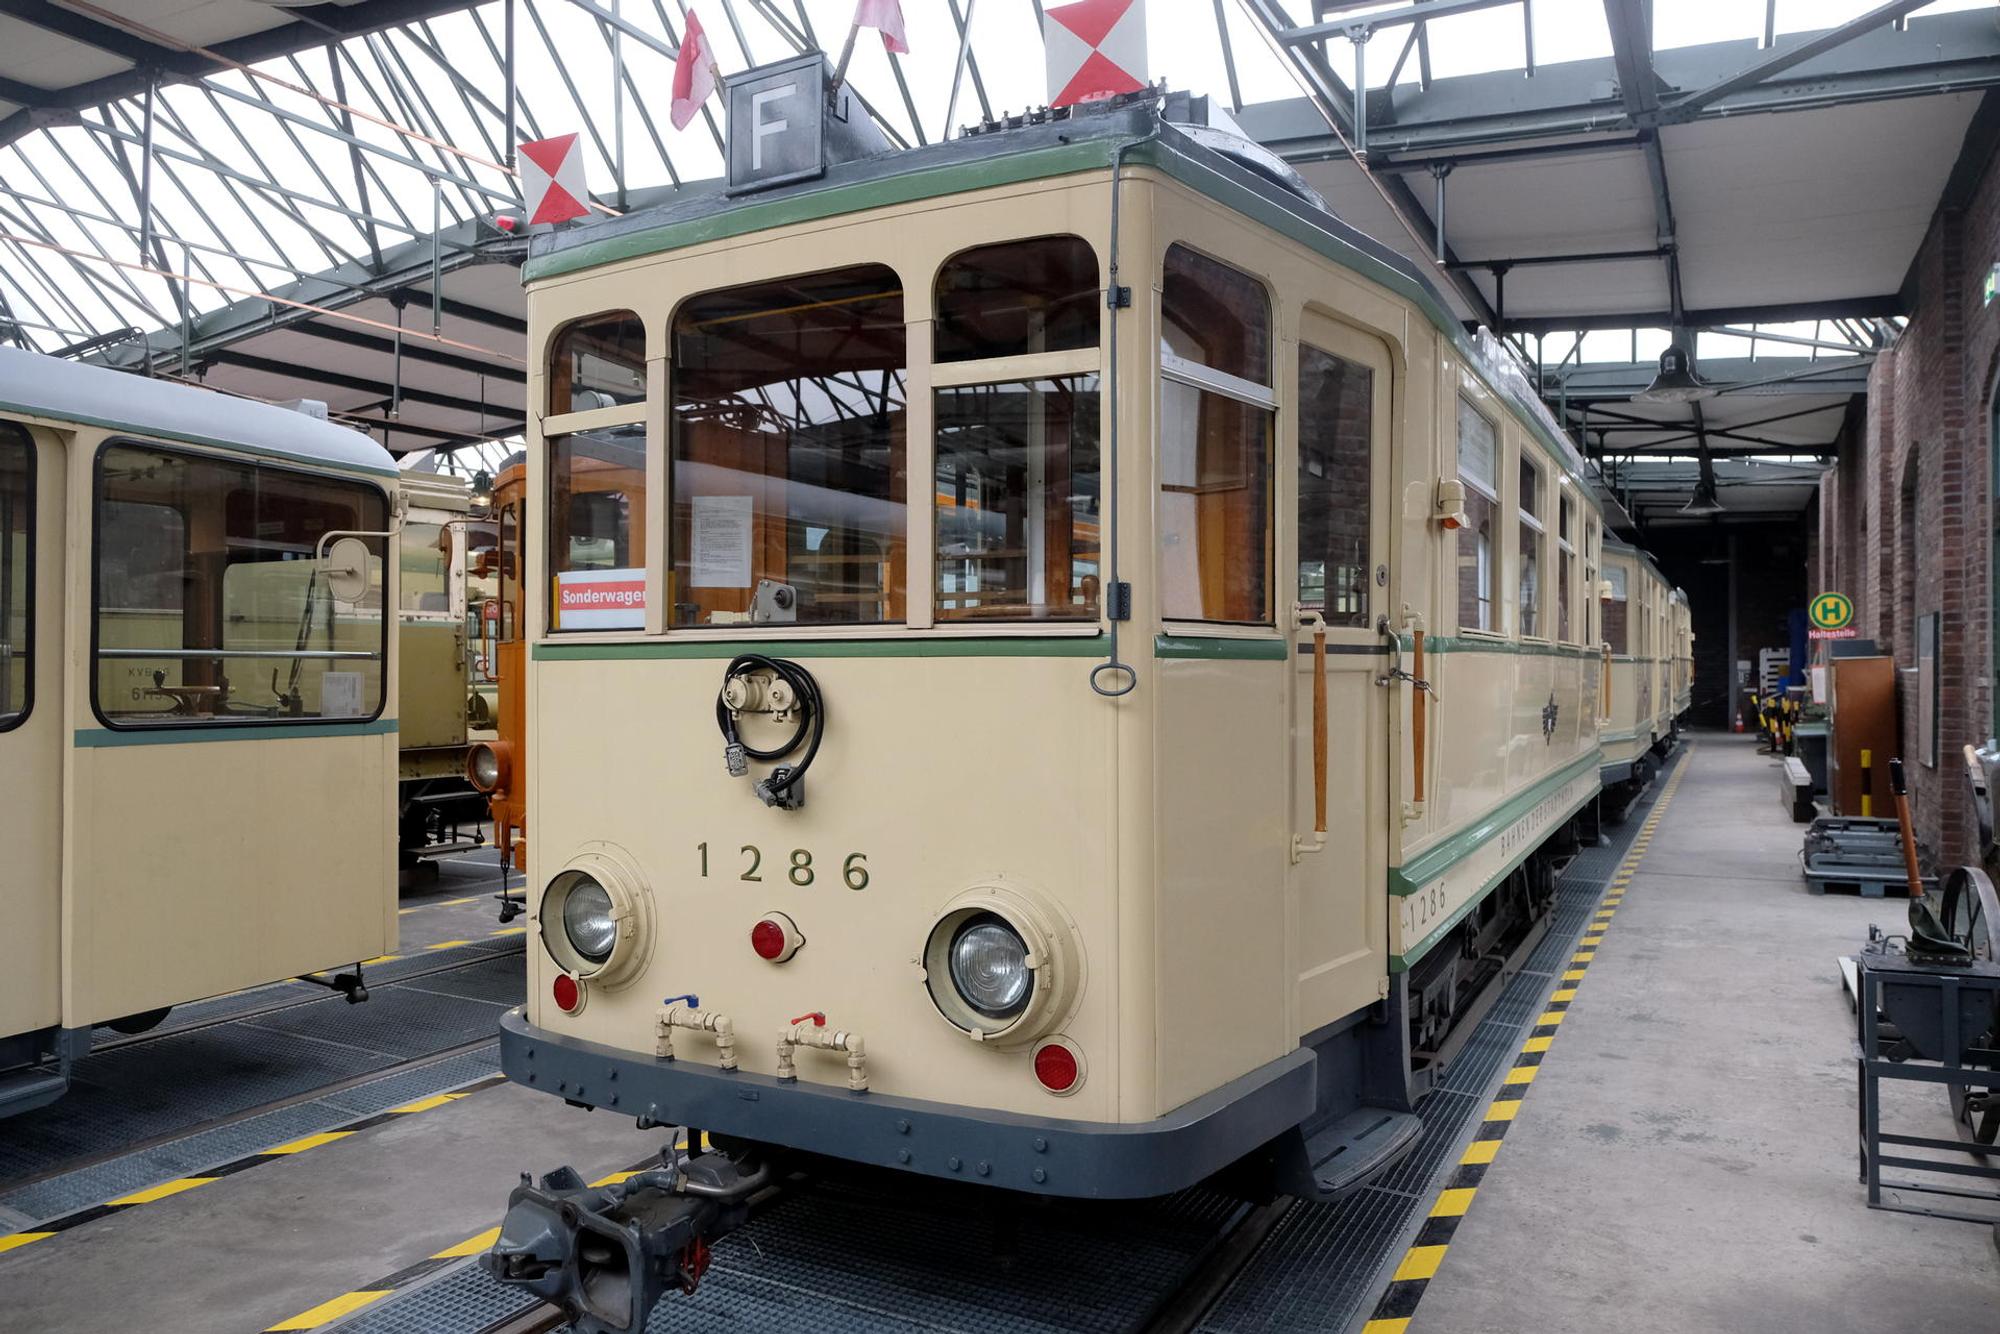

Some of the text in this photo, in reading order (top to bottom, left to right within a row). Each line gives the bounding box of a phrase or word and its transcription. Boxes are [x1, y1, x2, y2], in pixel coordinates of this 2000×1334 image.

[752, 83, 797, 171] F
[1808, 629, 1856, 639] Haltestelle
[1822, 601, 1841, 620] H
[697, 841, 870, 891] 1286
[1410, 881, 1446, 933] 1286
